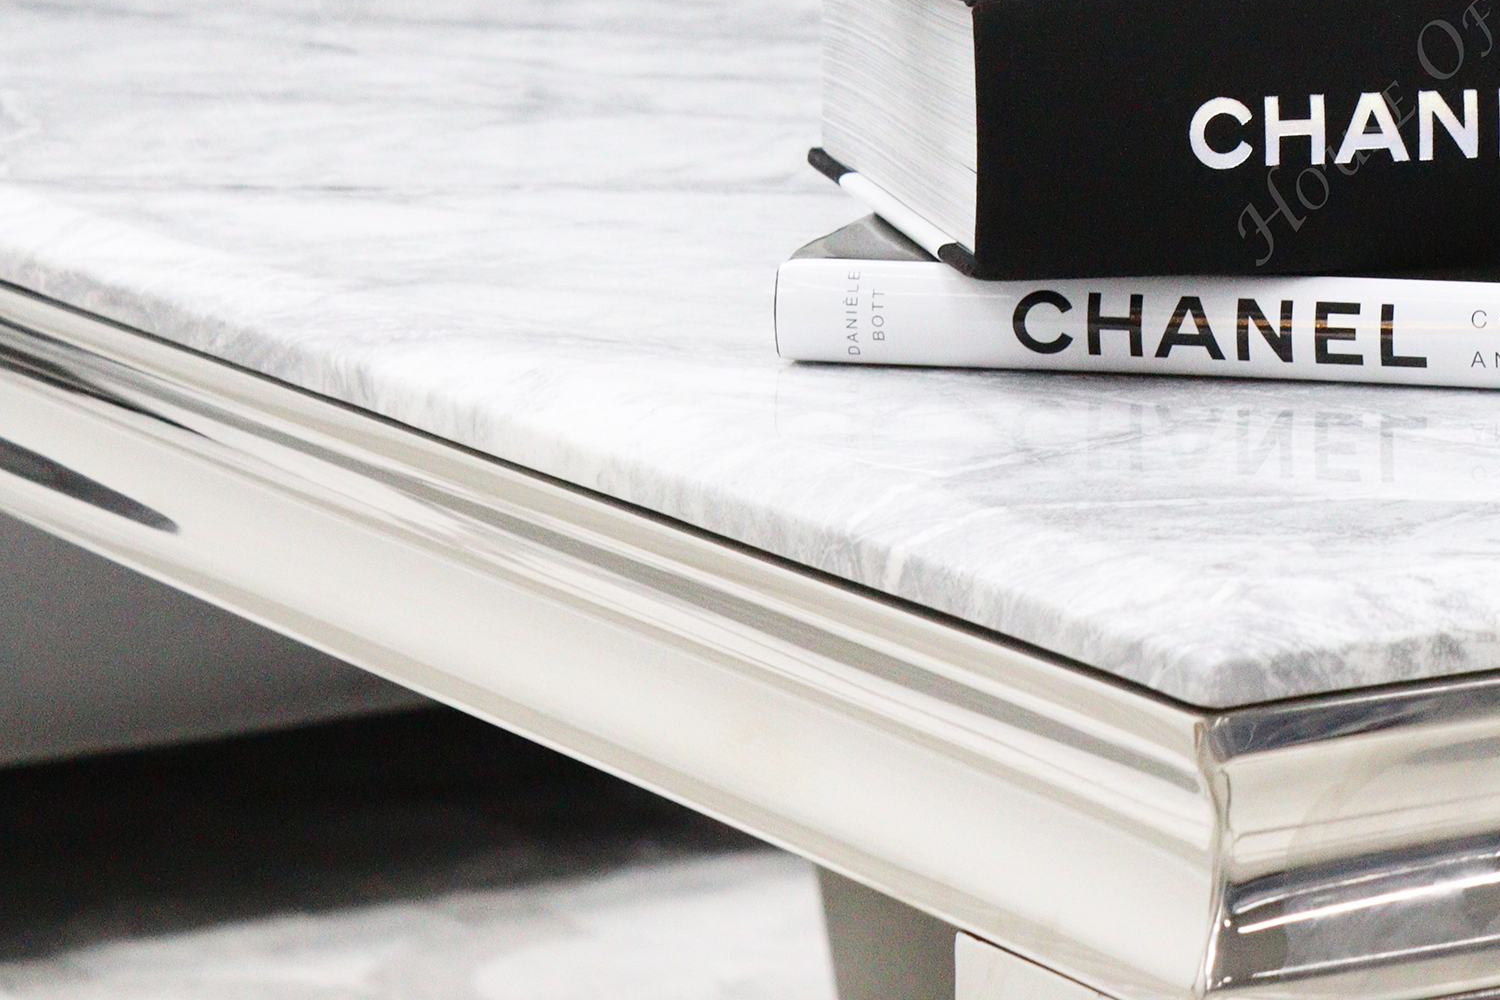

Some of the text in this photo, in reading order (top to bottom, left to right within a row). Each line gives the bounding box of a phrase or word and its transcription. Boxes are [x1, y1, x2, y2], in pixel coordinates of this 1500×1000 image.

[843, 270, 861, 356] DANIÈLE
[872, 289, 885, 341] BOTT
[1012, 289, 1428, 369] CHANEL
